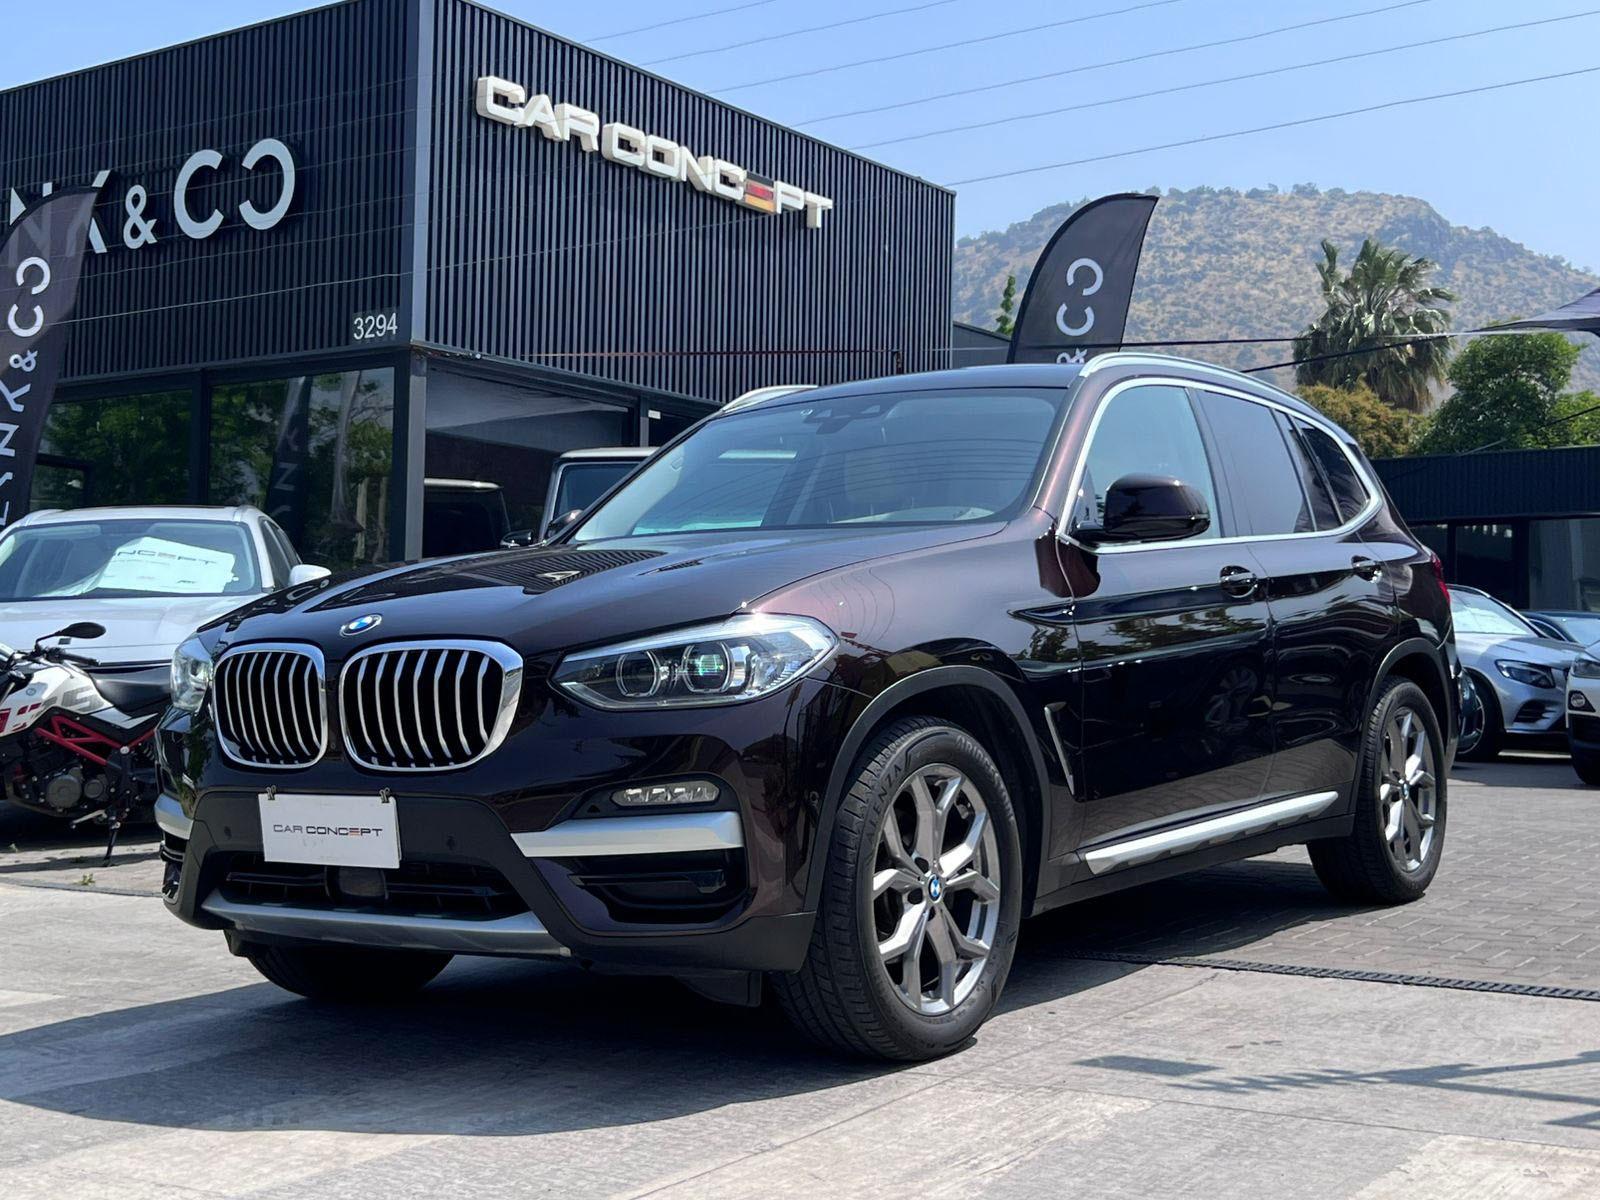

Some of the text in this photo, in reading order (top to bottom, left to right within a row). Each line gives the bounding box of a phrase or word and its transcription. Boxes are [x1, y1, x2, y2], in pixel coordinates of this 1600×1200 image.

[476, 75, 833, 229] CAR CONCEPT
[353, 312, 398, 340] 3294
[273, 824, 384, 837] CAR CONCEPT
